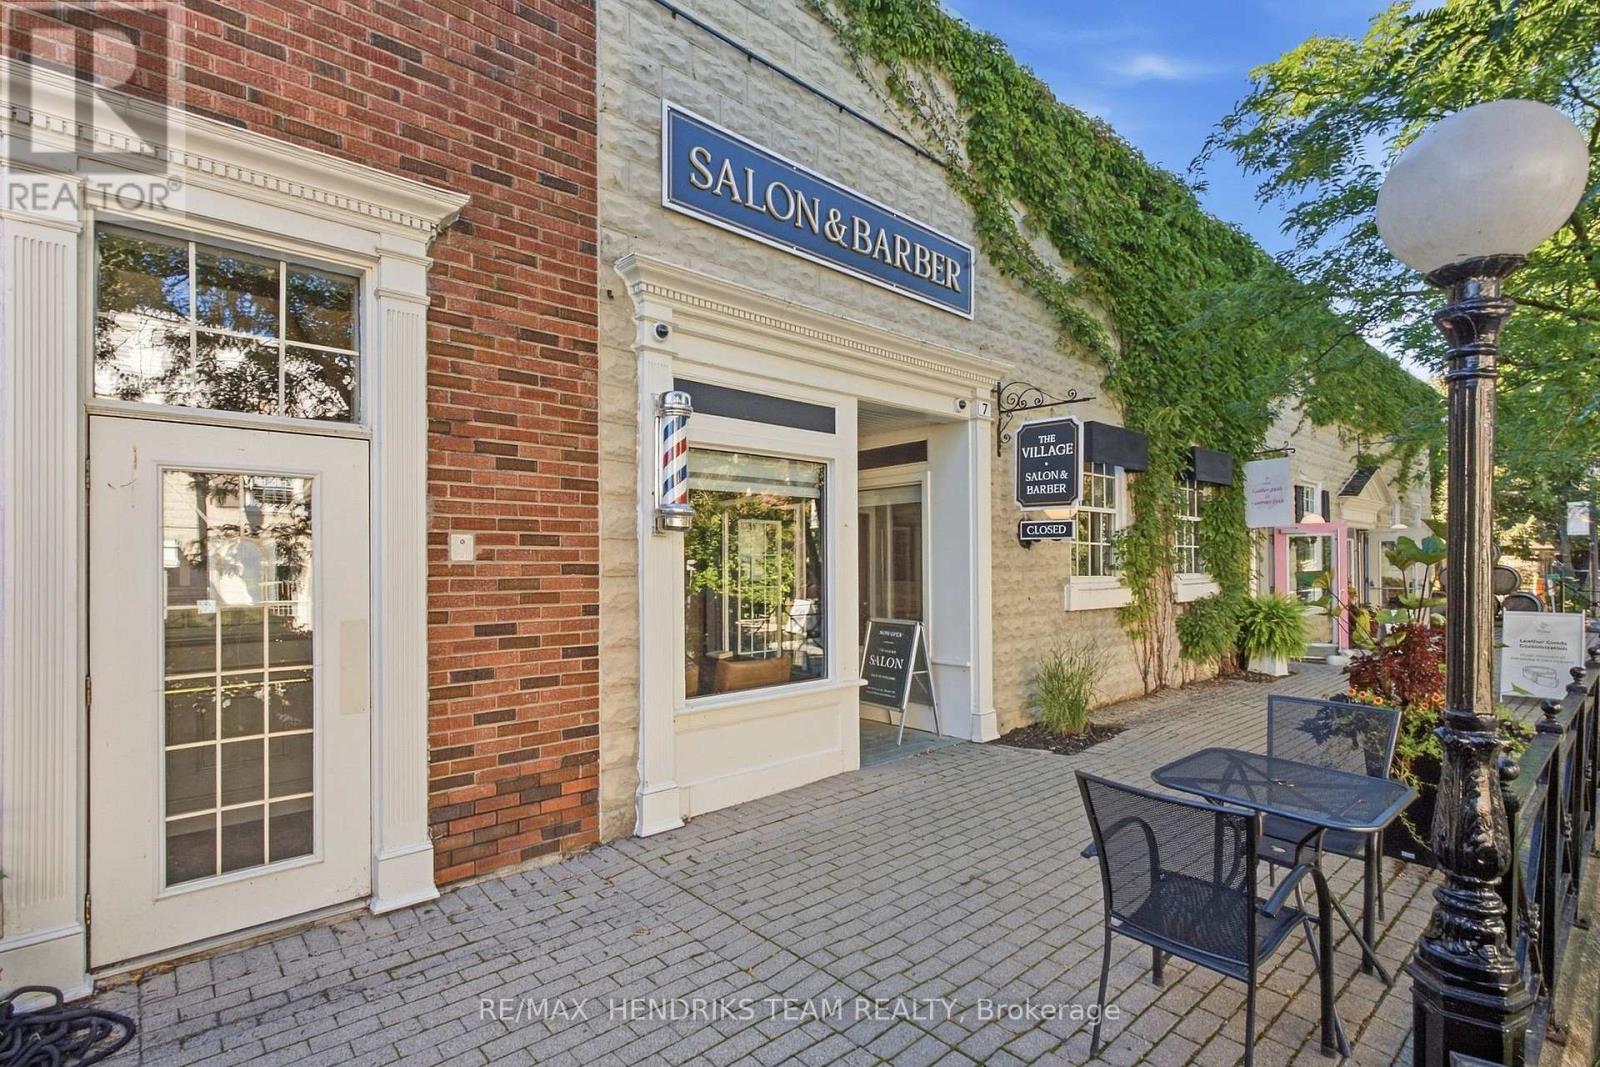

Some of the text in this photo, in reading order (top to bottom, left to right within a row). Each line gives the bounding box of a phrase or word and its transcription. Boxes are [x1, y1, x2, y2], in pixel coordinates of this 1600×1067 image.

[982, 402, 988, 415] 7
[1038, 434, 1056, 444] THE
[1022, 443, 1074, 459] VILLAGE
[1025, 470, 1069, 482] SALON &
[1026, 483, 1067, 495] BARBER
[1026, 524, 1067, 535] CLOSED
[869, 654, 904, 669] SALON
